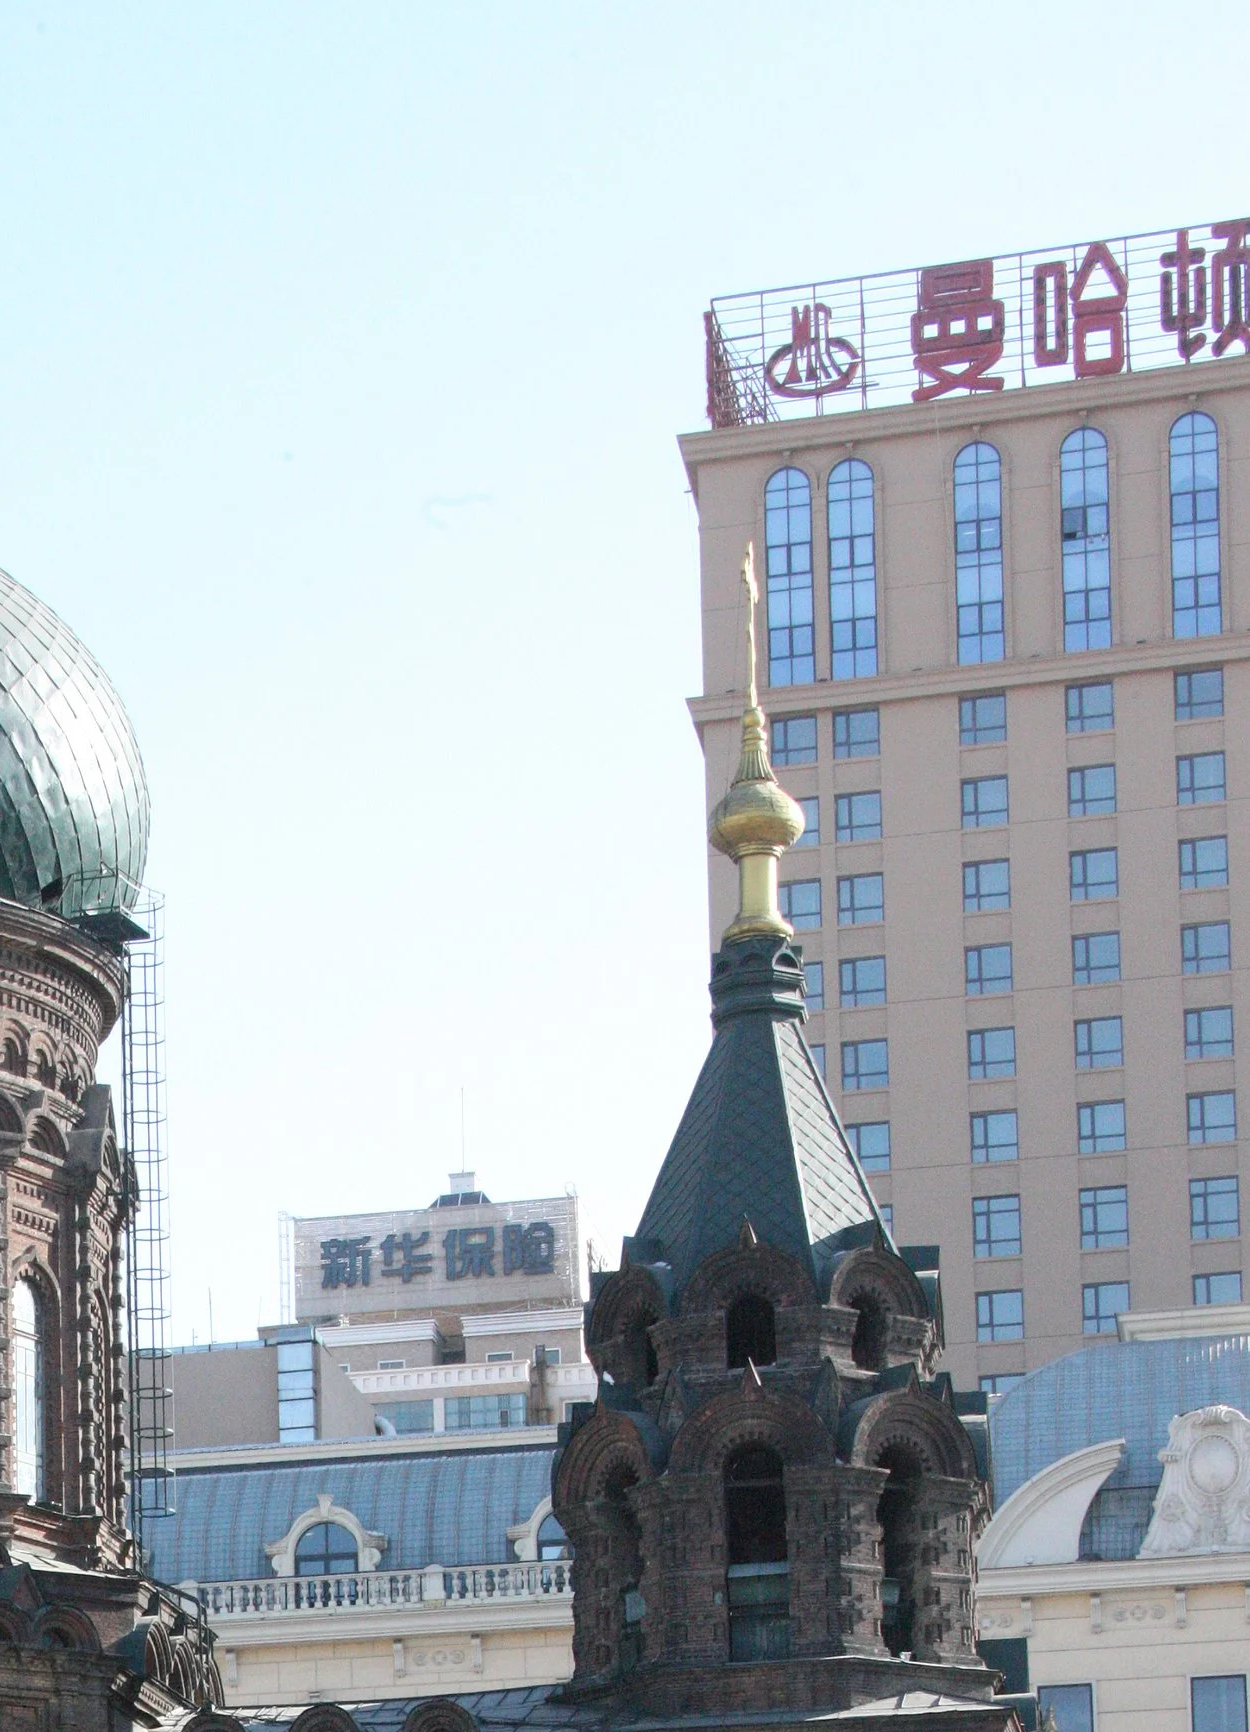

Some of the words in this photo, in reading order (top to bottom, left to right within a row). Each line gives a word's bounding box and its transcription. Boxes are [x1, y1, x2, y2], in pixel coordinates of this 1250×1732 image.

[910, 221, 1250, 401] 曼哈顿
[320, 1221, 554, 1289] 新华保险
